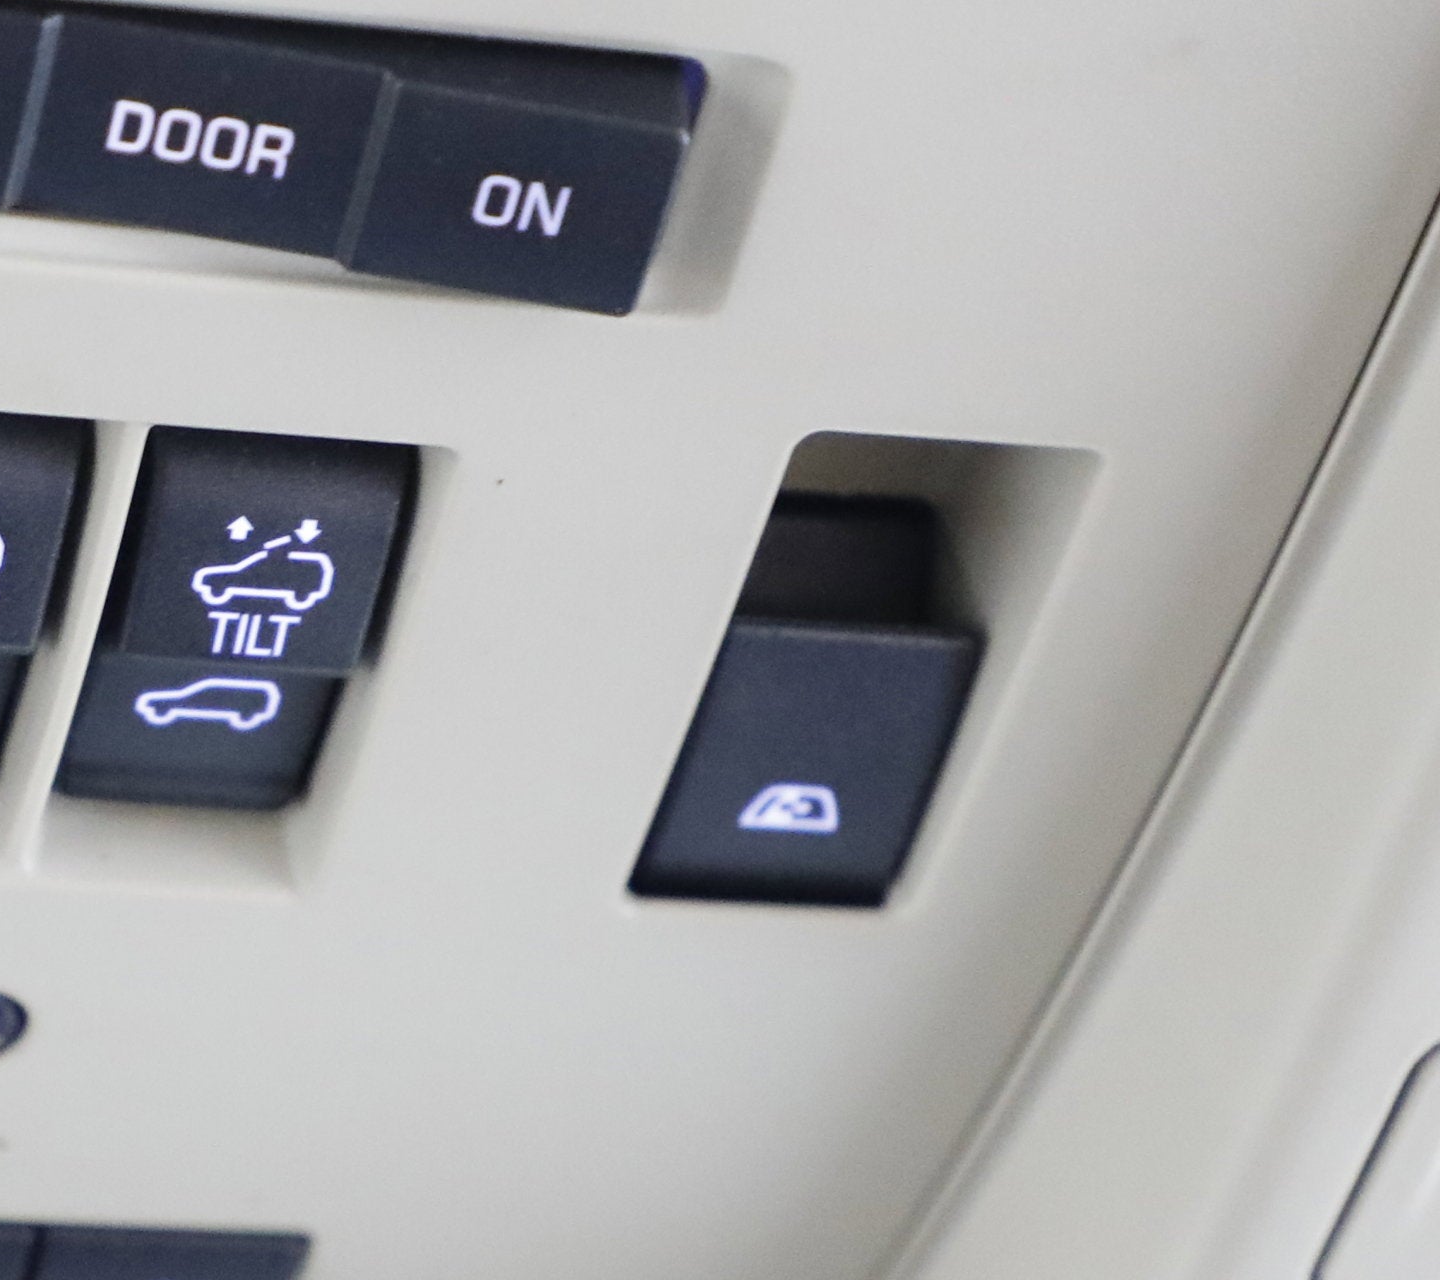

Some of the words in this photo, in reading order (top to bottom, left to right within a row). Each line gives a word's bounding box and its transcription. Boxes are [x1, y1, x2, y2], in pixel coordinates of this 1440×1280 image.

[105, 99, 295, 179] DOOR
[472, 174, 572, 237] ON
[207, 610, 303, 658] TILT
